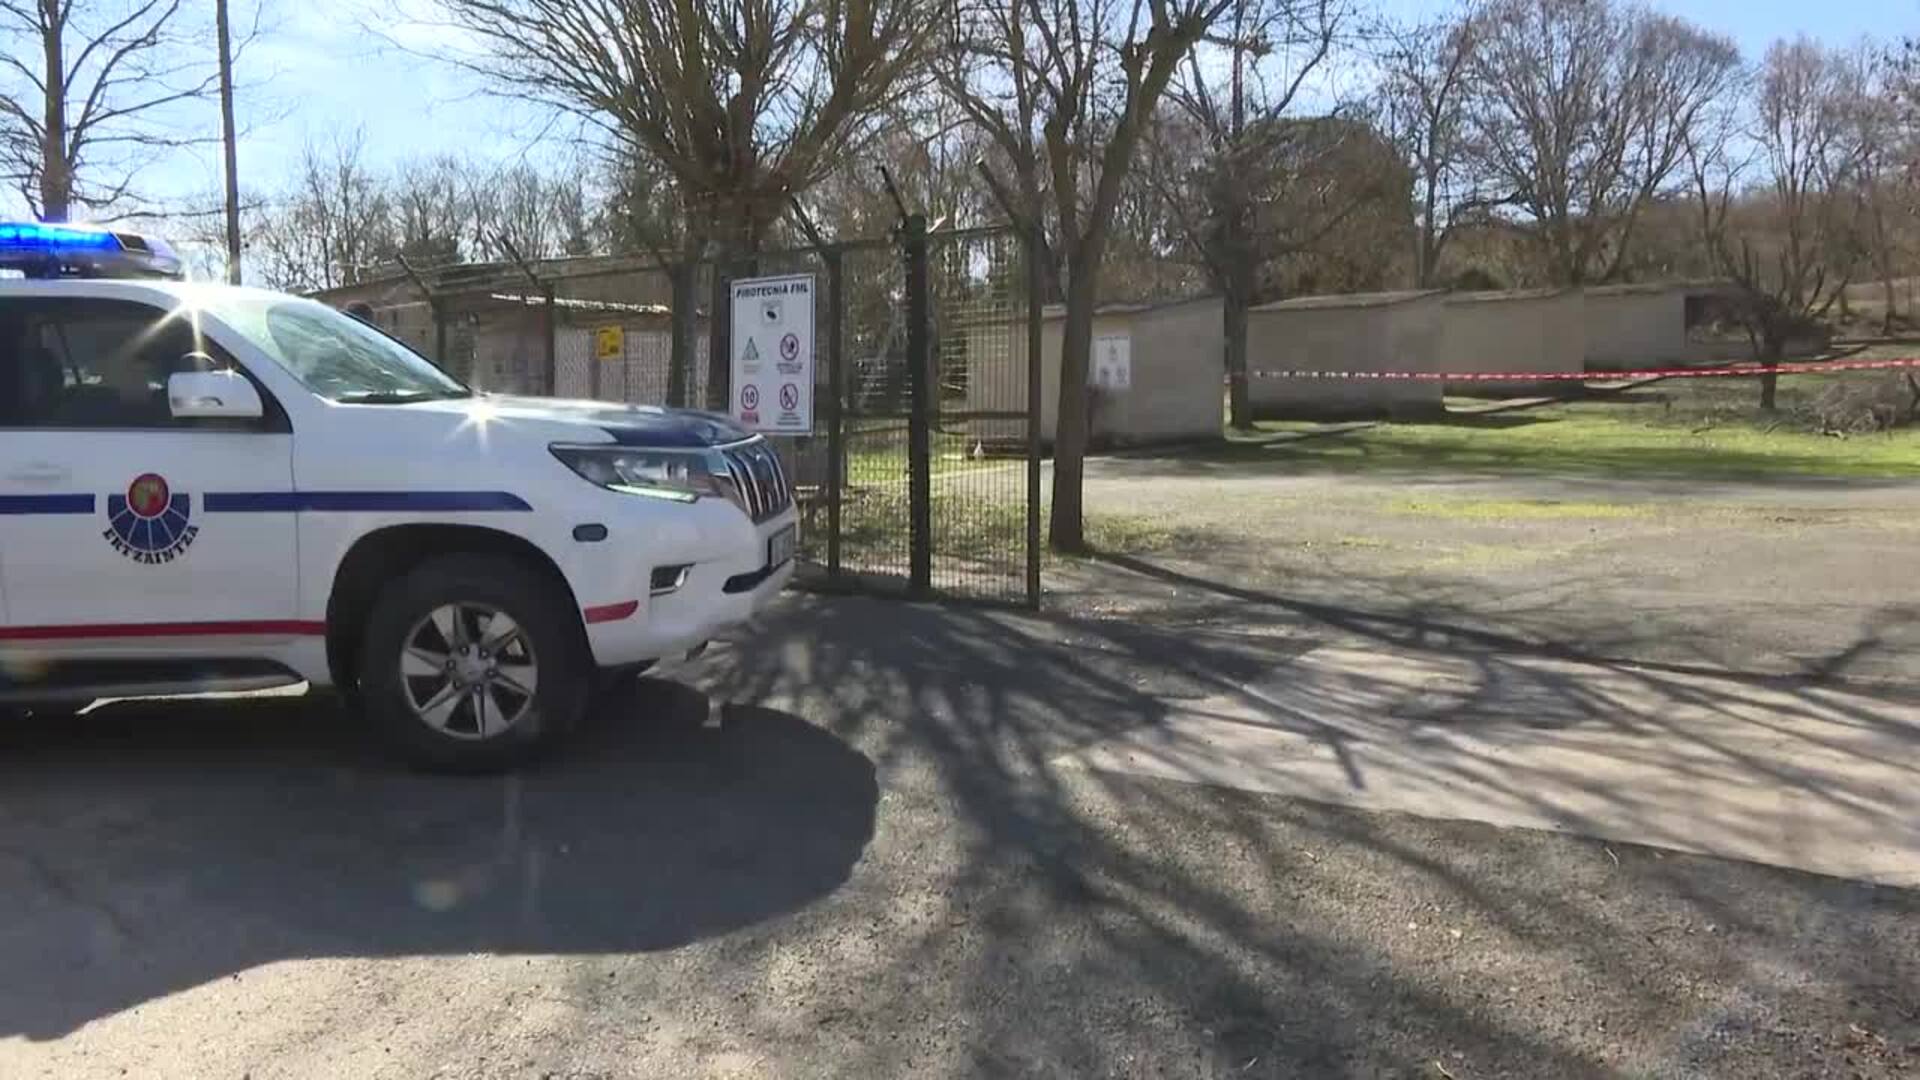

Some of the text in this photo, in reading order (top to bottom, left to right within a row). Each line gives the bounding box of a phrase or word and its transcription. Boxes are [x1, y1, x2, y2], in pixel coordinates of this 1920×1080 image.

[736, 284, 788, 298] PIROTECNIA
[745, 391, 755, 404] 10
[102, 526, 199, 564] ERTZAINTZA
